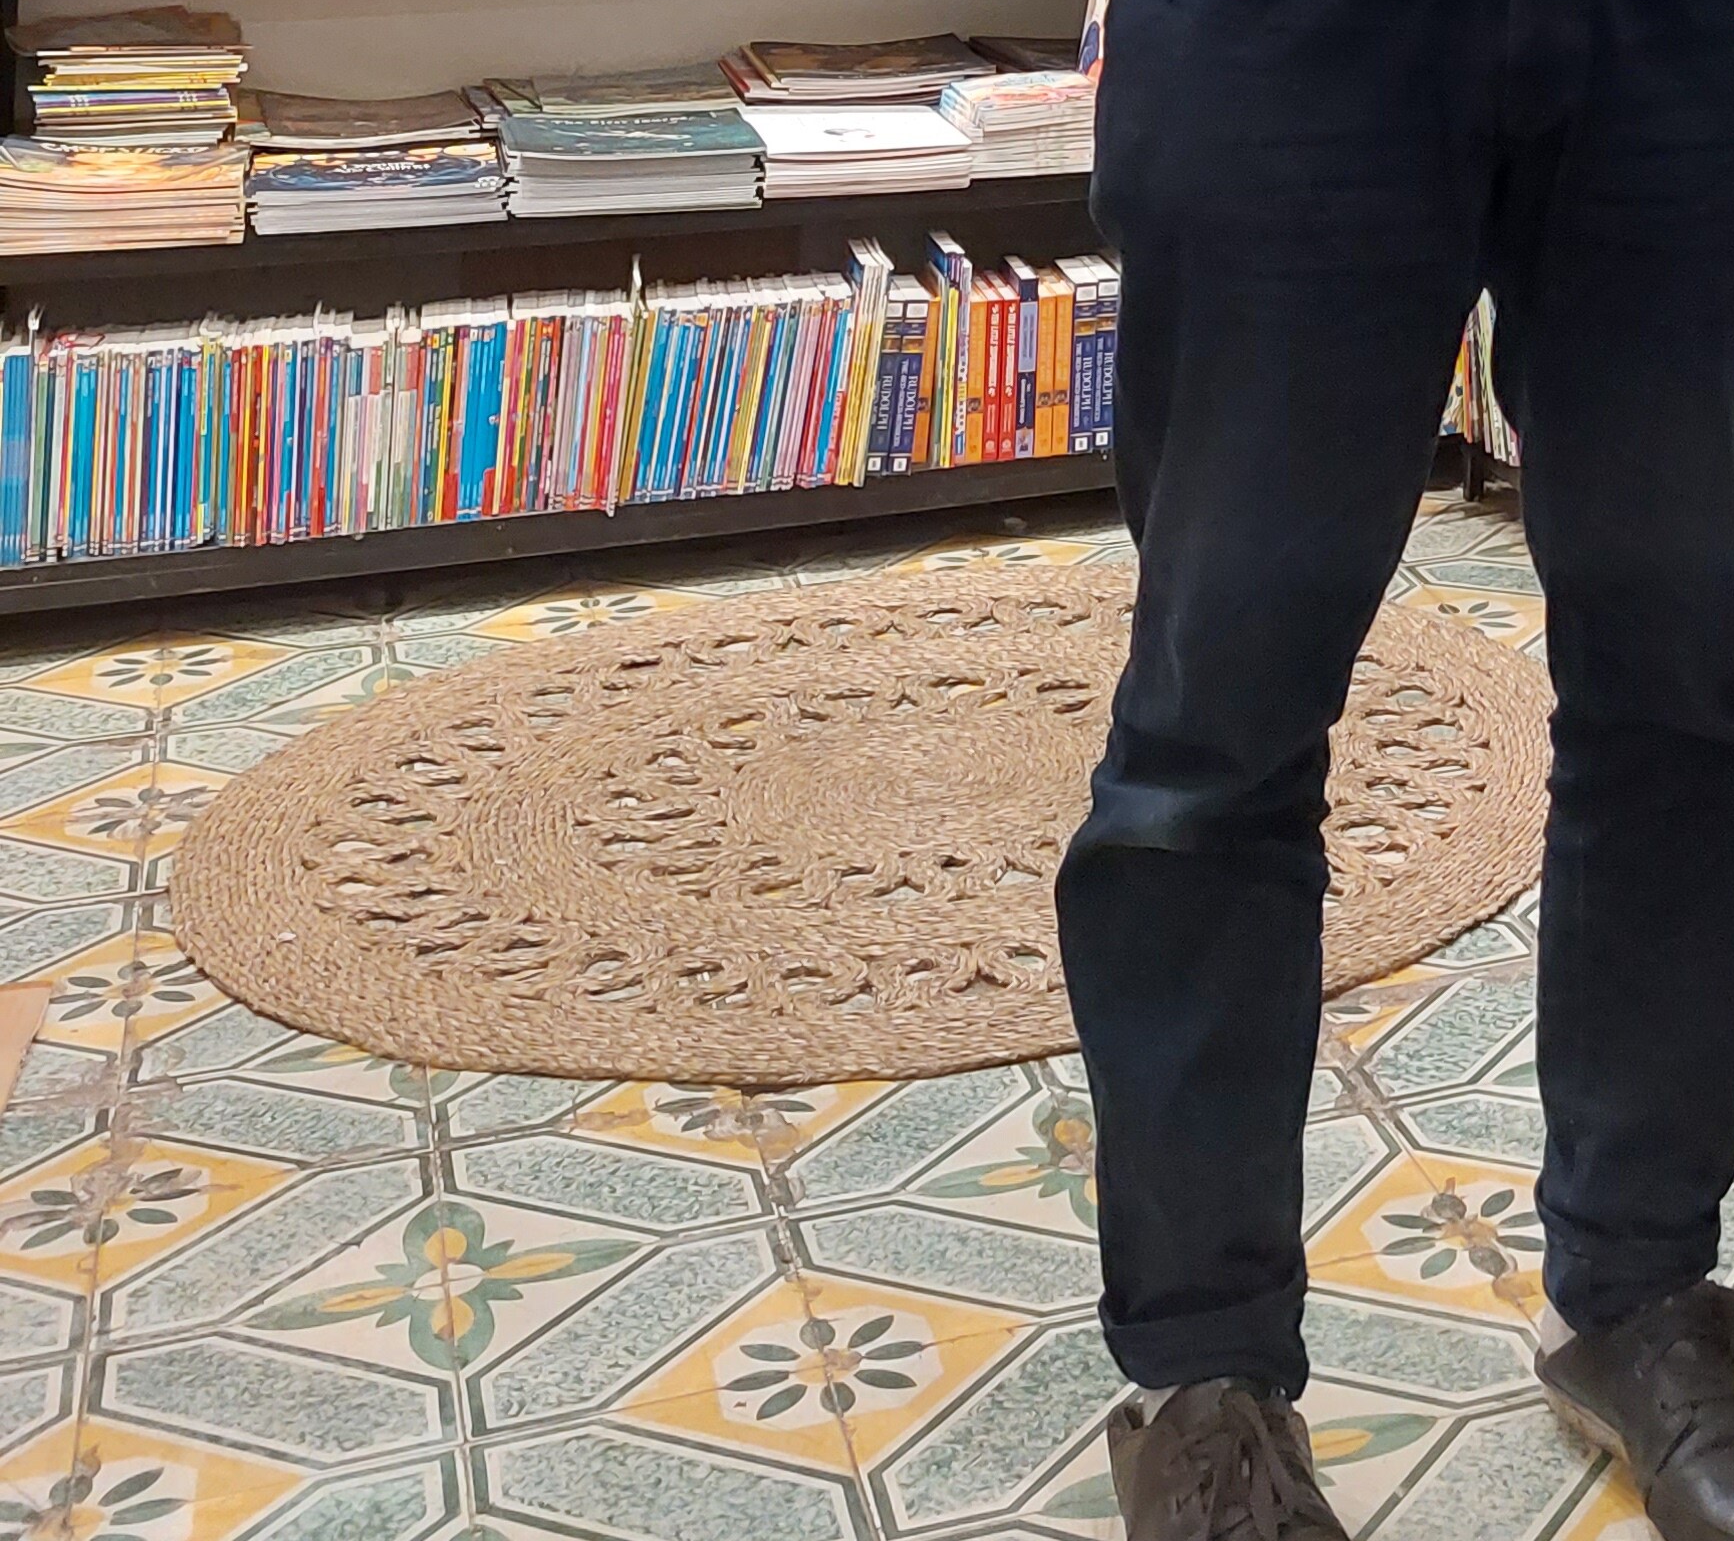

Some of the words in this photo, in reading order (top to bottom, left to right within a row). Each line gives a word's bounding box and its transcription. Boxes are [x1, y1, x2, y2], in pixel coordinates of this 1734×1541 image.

[876, 375, 894, 430] RUDOLPH
[902, 375, 919, 431] RUDOLPH
[1081, 356, 1093, 410] RUDOLPH
[1102, 352, 1114, 405] RUDOLPH
